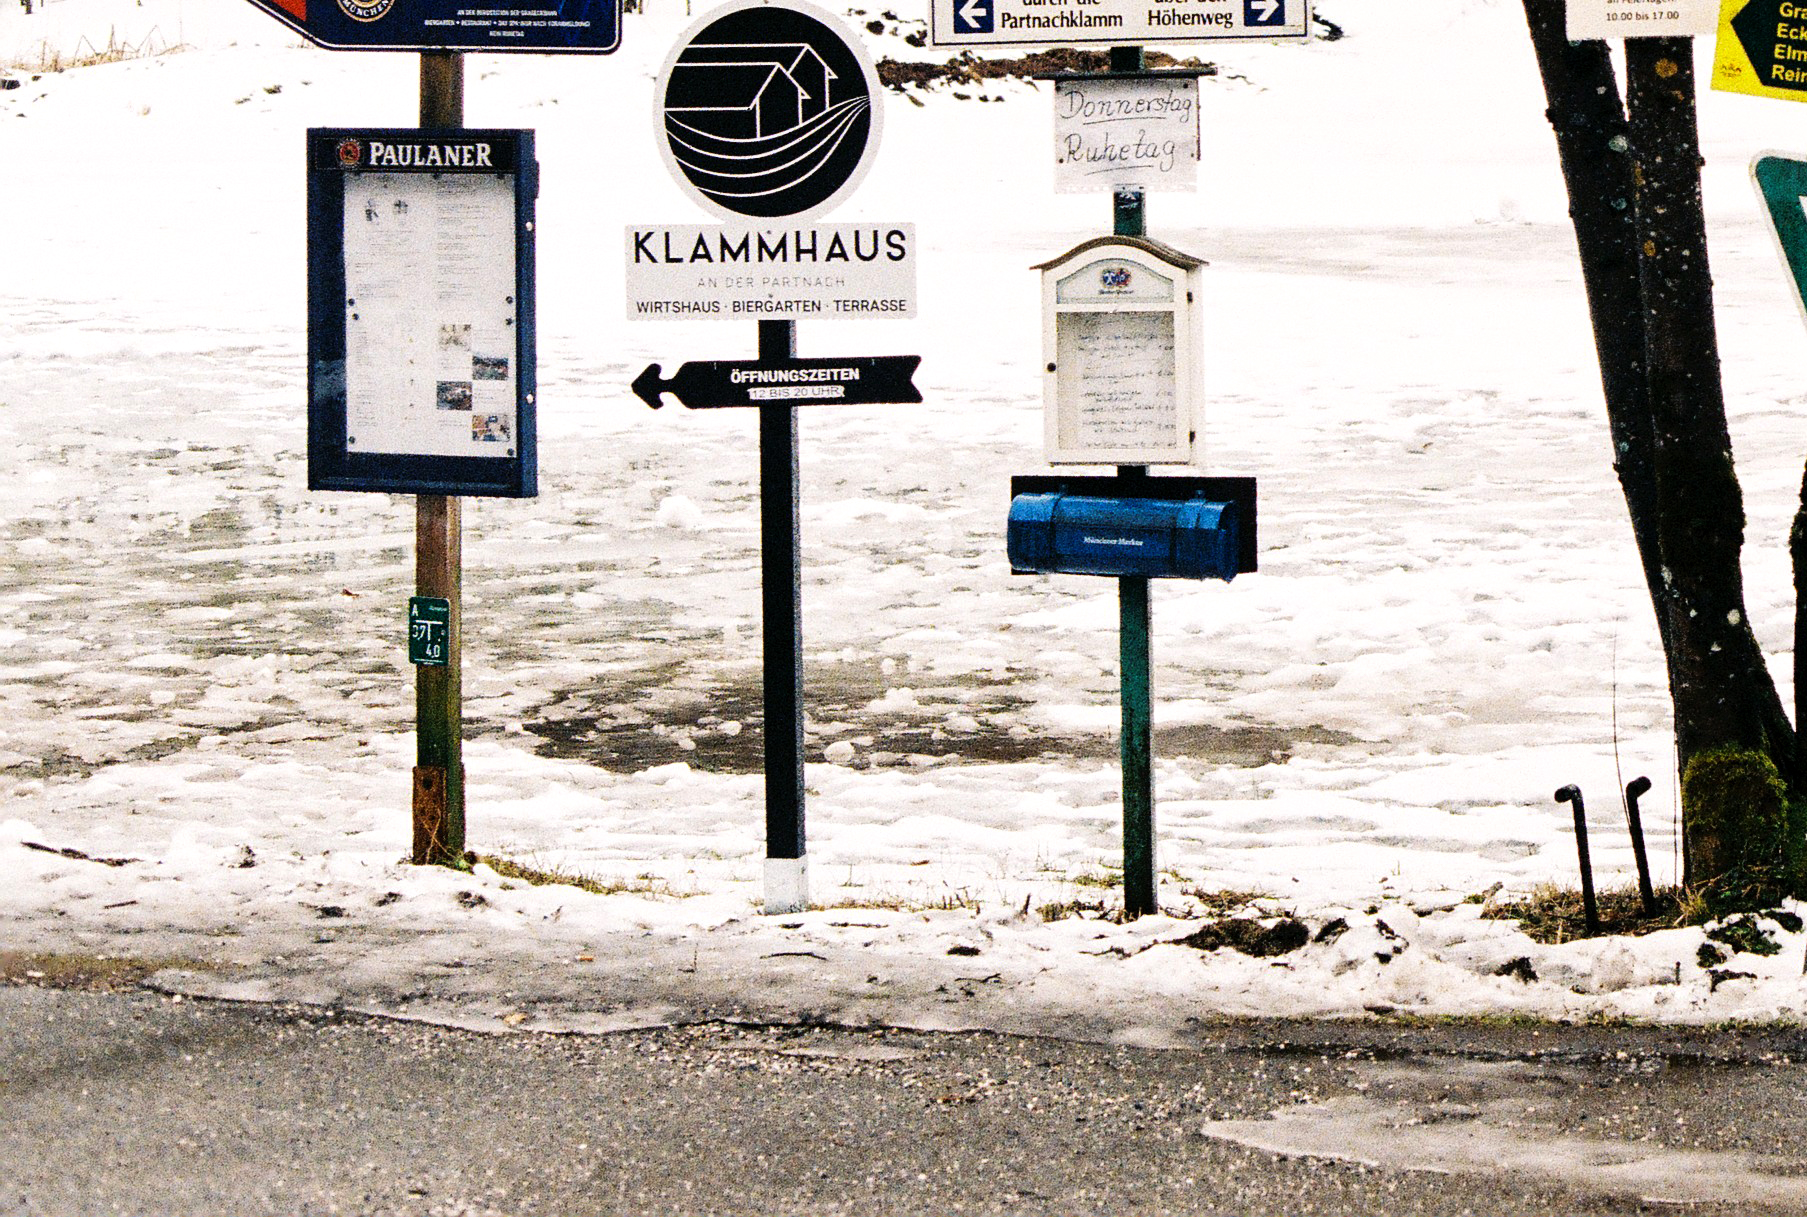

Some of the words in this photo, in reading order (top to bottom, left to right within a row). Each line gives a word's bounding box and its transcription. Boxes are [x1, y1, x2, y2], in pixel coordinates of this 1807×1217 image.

[1001, 9, 1123, 29] Partnachklamm
[1148, 8, 1234, 28] Höhenweg
[1635, 12, 1649, 20] bis
[1061, 90, 1193, 124] Donnerstag
[369, 141, 493, 168] PAULANER
[1064, 129, 1176, 173] Ruhetag
[634, 230, 907, 264] KLAMMHAUS
[698, 278, 718, 288] AN
[725, 277, 754, 288] DER
[762, 276, 846, 288] PARTNACH
[636, 301, 721, 313] WIRTSHAUS
[732, 300, 822, 313] BIERGARTEN
[834, 299, 907, 312] TERRASSE
[730, 367, 860, 384] ÖFFNUNGSZEITEN
[753, 387, 766, 399] 12
[769, 387, 790, 398] BIS
[794, 387, 808, 397] 20
